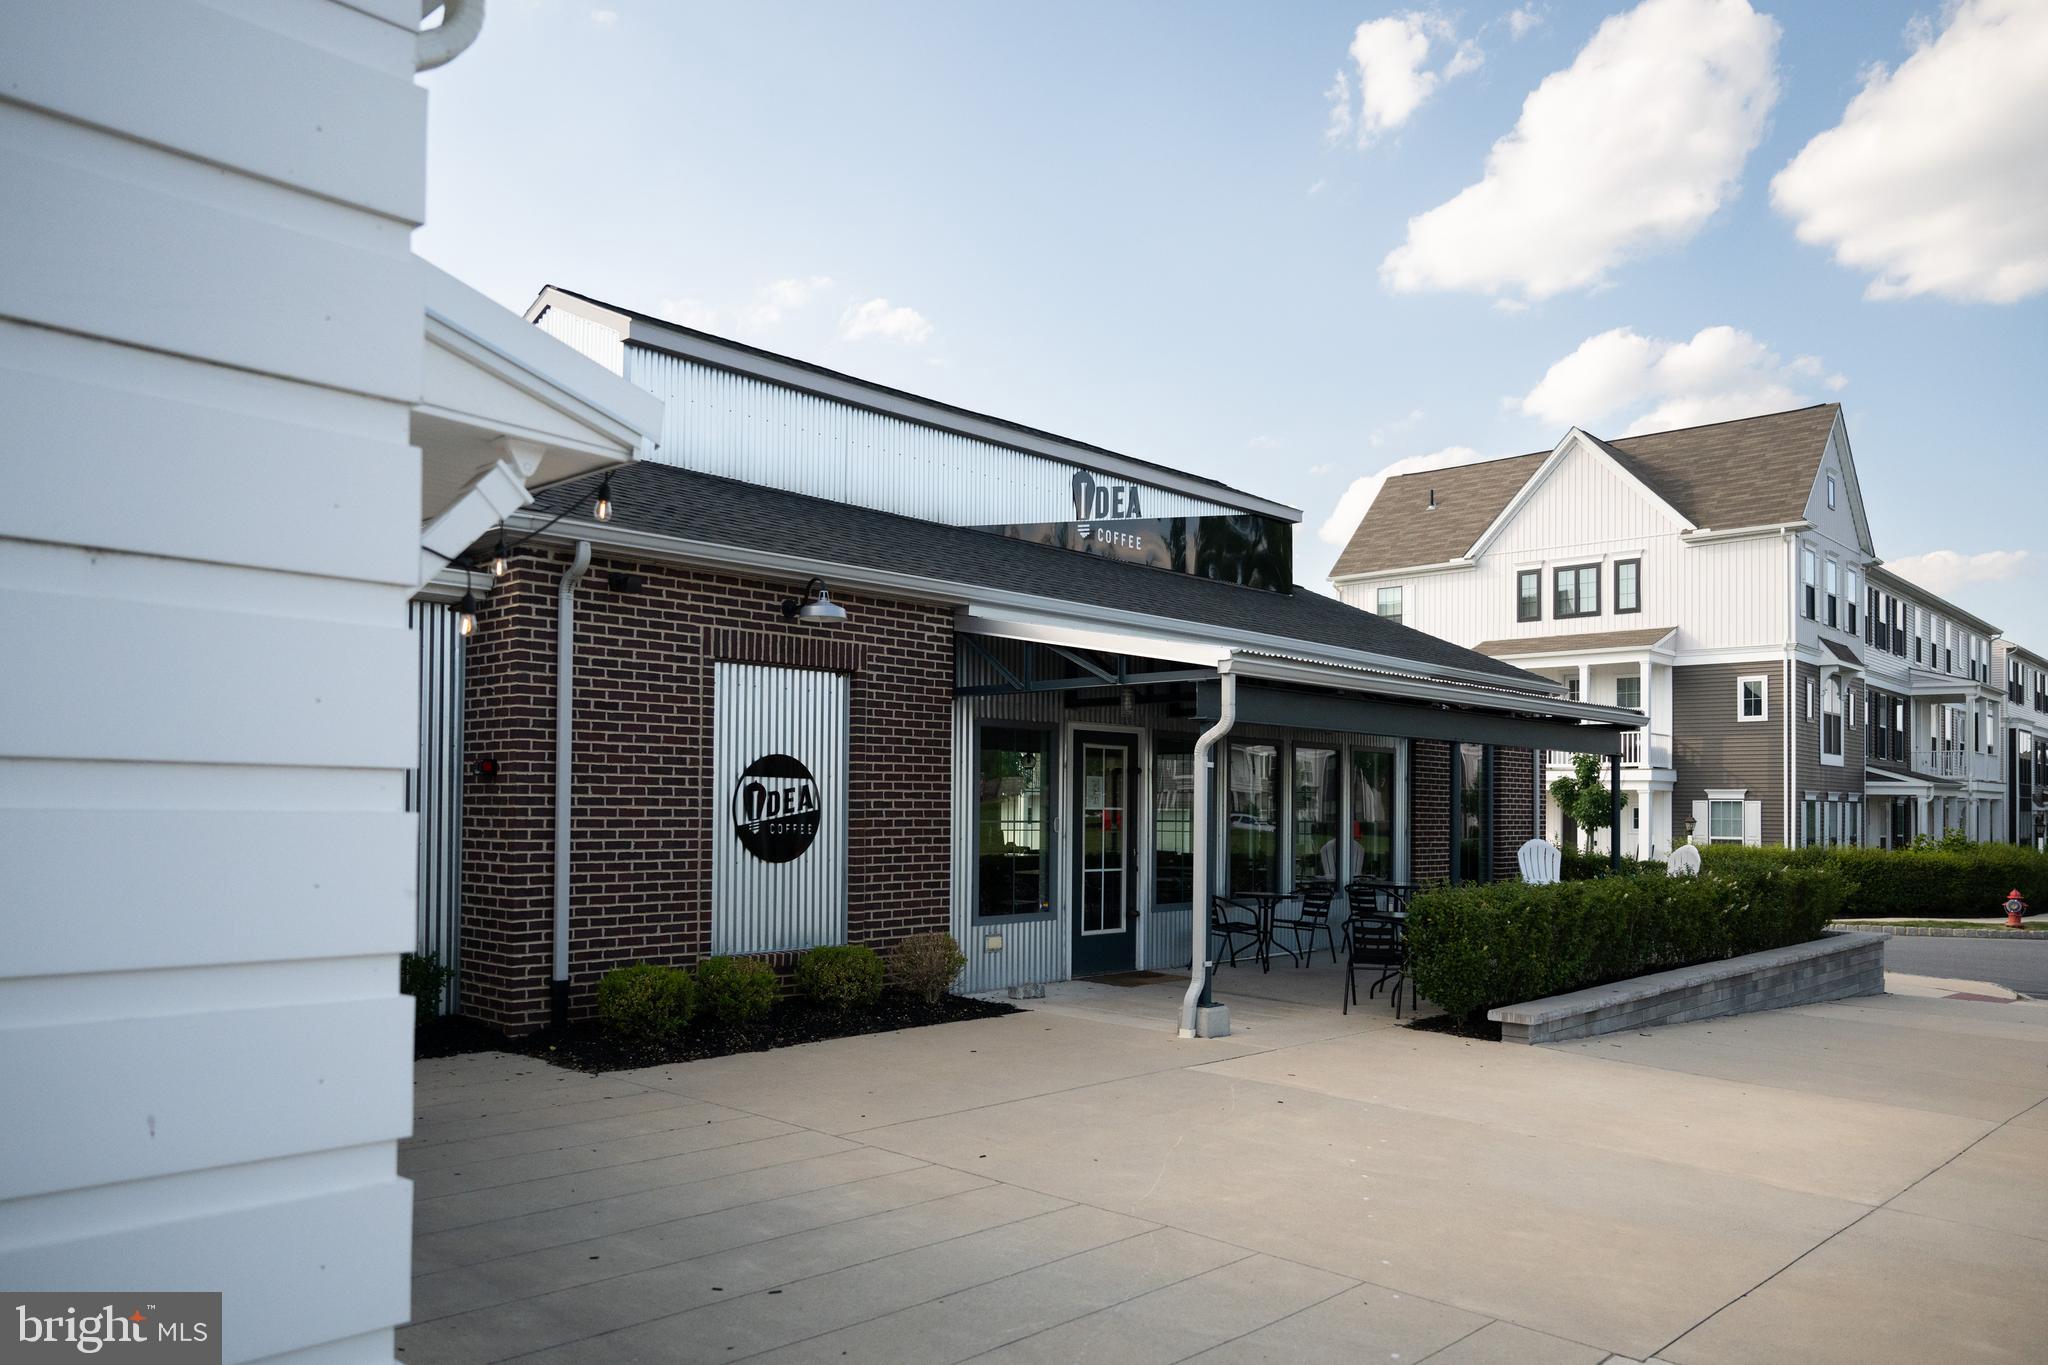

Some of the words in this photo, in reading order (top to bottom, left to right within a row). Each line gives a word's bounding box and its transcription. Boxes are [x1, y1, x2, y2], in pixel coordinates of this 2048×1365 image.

[1076, 477, 1142, 520] IDEA
[1097, 527, 1142, 551] COFFEE
[747, 783, 814, 821] IDEA
[769, 823, 813, 835] COFFEE
